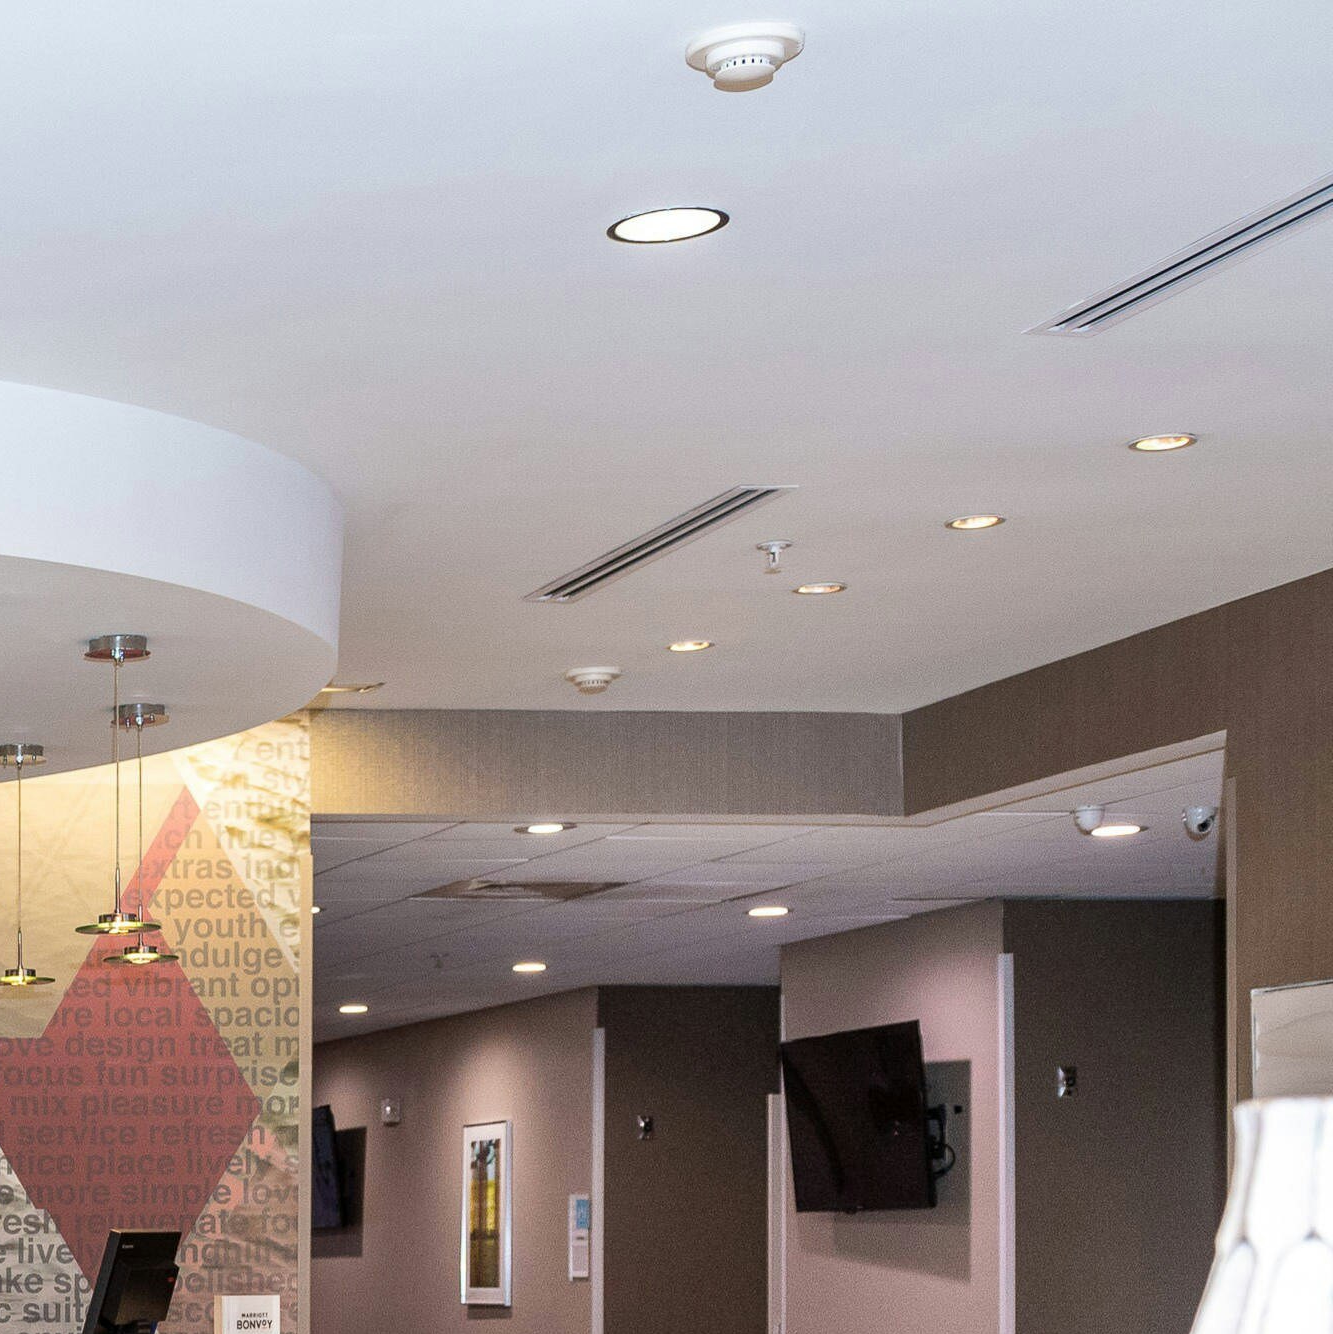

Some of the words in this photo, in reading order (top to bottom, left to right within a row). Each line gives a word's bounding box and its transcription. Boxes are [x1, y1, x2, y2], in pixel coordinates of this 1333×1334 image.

[126, 883, 275, 916] expected
[175, 912, 267, 944] youth
[125, 972, 239, 997] vibrant
[106, 1001, 182, 1026] local
[65, 1031, 187, 1063] design
[188, 1032, 265, 1056] treat
[96, 1060, 149, 1086] fun
[160, 1060, 298, 1093] surprise
[10, 1090, 69, 1116] mix
[81, 1090, 225, 1122] pleasure
[18, 1120, 138, 1146] service
[149, 1120, 266, 1146] refresh
[86, 1150, 176, 1182] place
[186, 1150, 271, 1182] lively
[26, 1185, 111, 1205] more
[122, 1179, 232, 1212] simple
